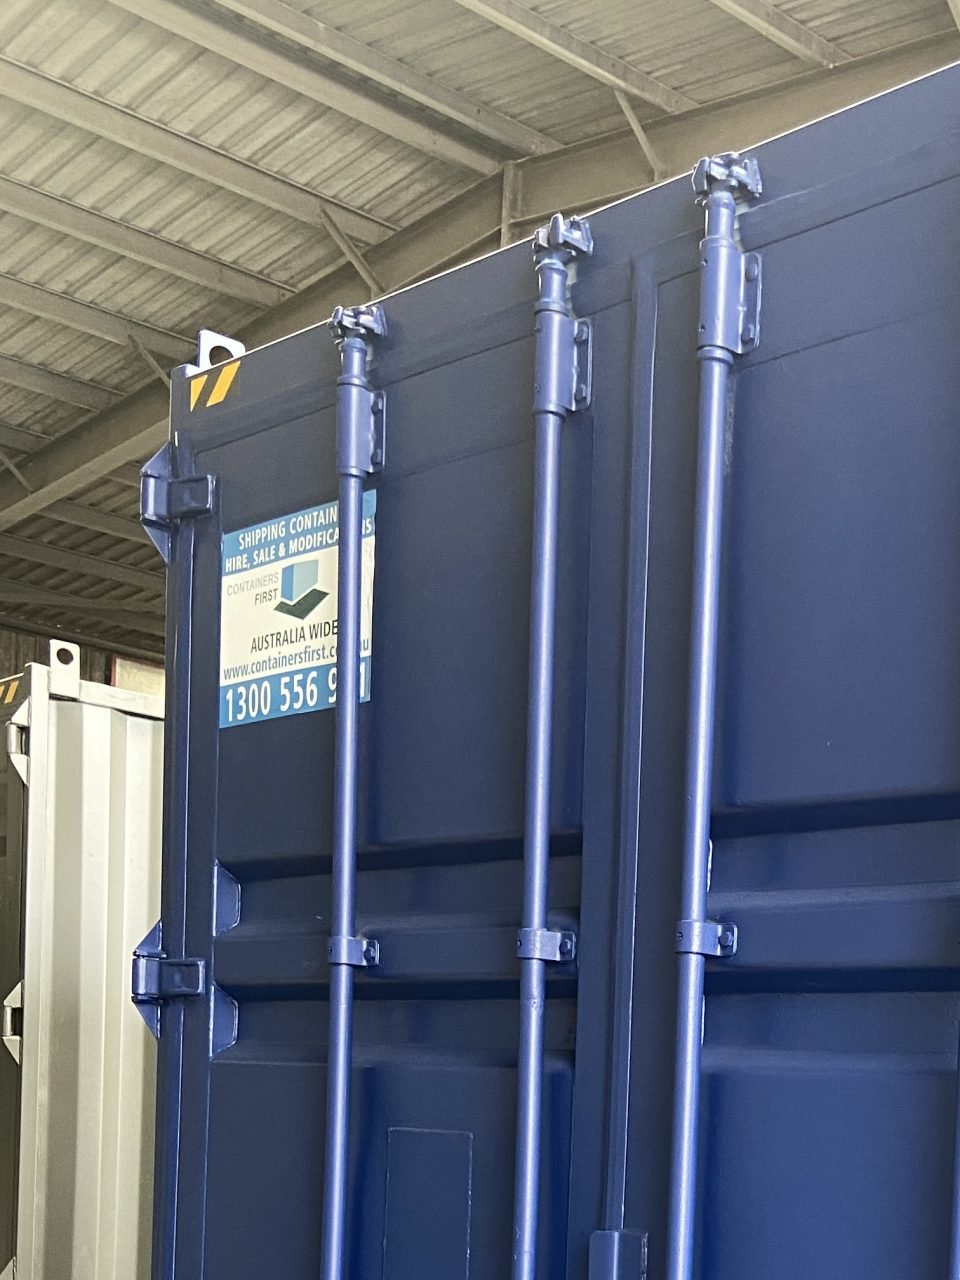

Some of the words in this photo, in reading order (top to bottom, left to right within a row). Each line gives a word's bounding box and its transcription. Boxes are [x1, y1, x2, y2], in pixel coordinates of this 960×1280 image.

[225, 553, 250, 573] HIRE,
[253, 545, 276, 565] SALE
[278, 542, 286, 557] &
[288, 518, 372, 554] MODIFICAS
[239, 521, 286, 550] SHIPPING
[289, 505, 338, 534] CONTAIN
[226, 571, 279, 597] CONTAINERS
[254, 588, 279, 606] FIRST
[250, 626, 306, 654] AUSTRALIA
[308, 619, 338, 640] WIDE
[223, 639, 369, 680] www.containersfirst.cu
[225, 680, 271, 722] 1300
[279, 670, 319, 712] 556
[327, 661, 366, 704] 91
